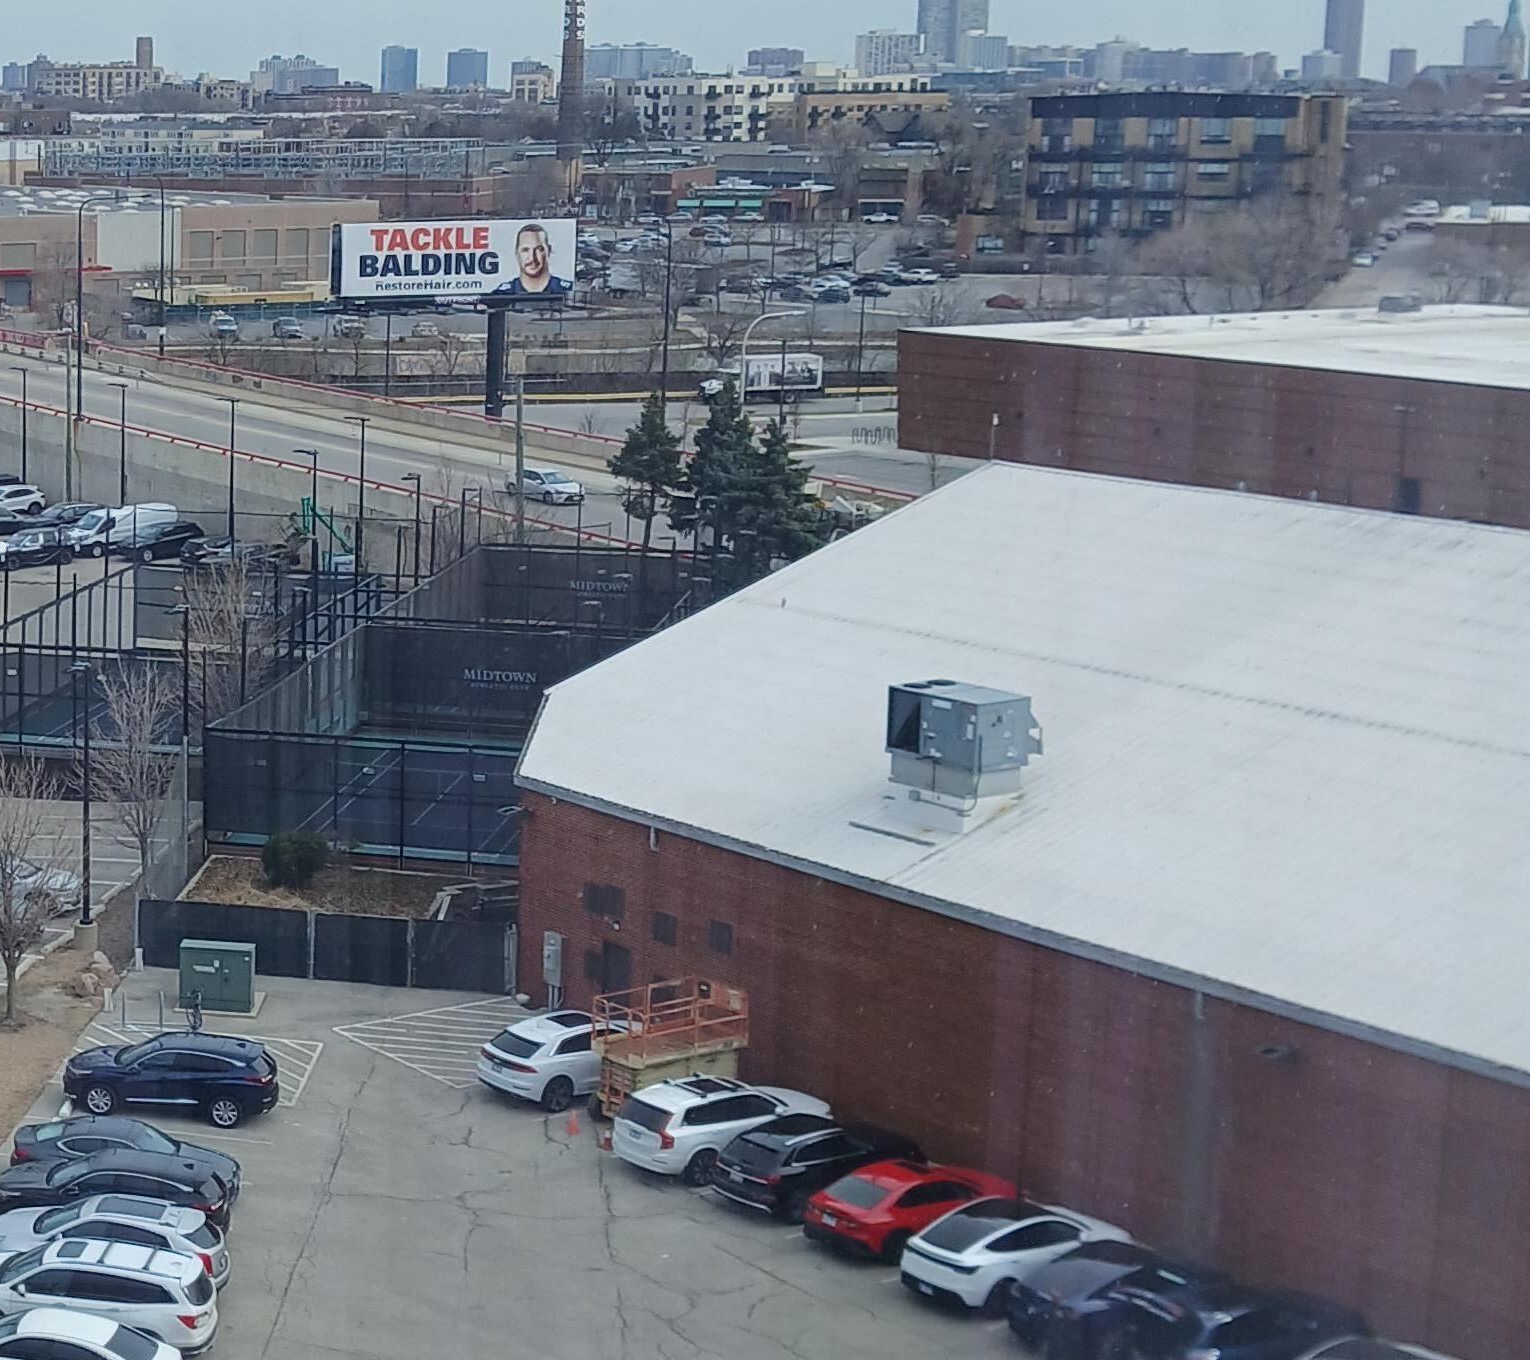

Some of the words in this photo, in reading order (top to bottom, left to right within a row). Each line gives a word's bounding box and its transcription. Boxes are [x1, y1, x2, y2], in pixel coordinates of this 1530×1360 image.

[370, 227, 489, 252] TACKLE
[359, 251, 499, 277] BALDING
[375, 280, 482, 291] RestoreHair.com
[463, 668, 537, 683] MIDTOWN
